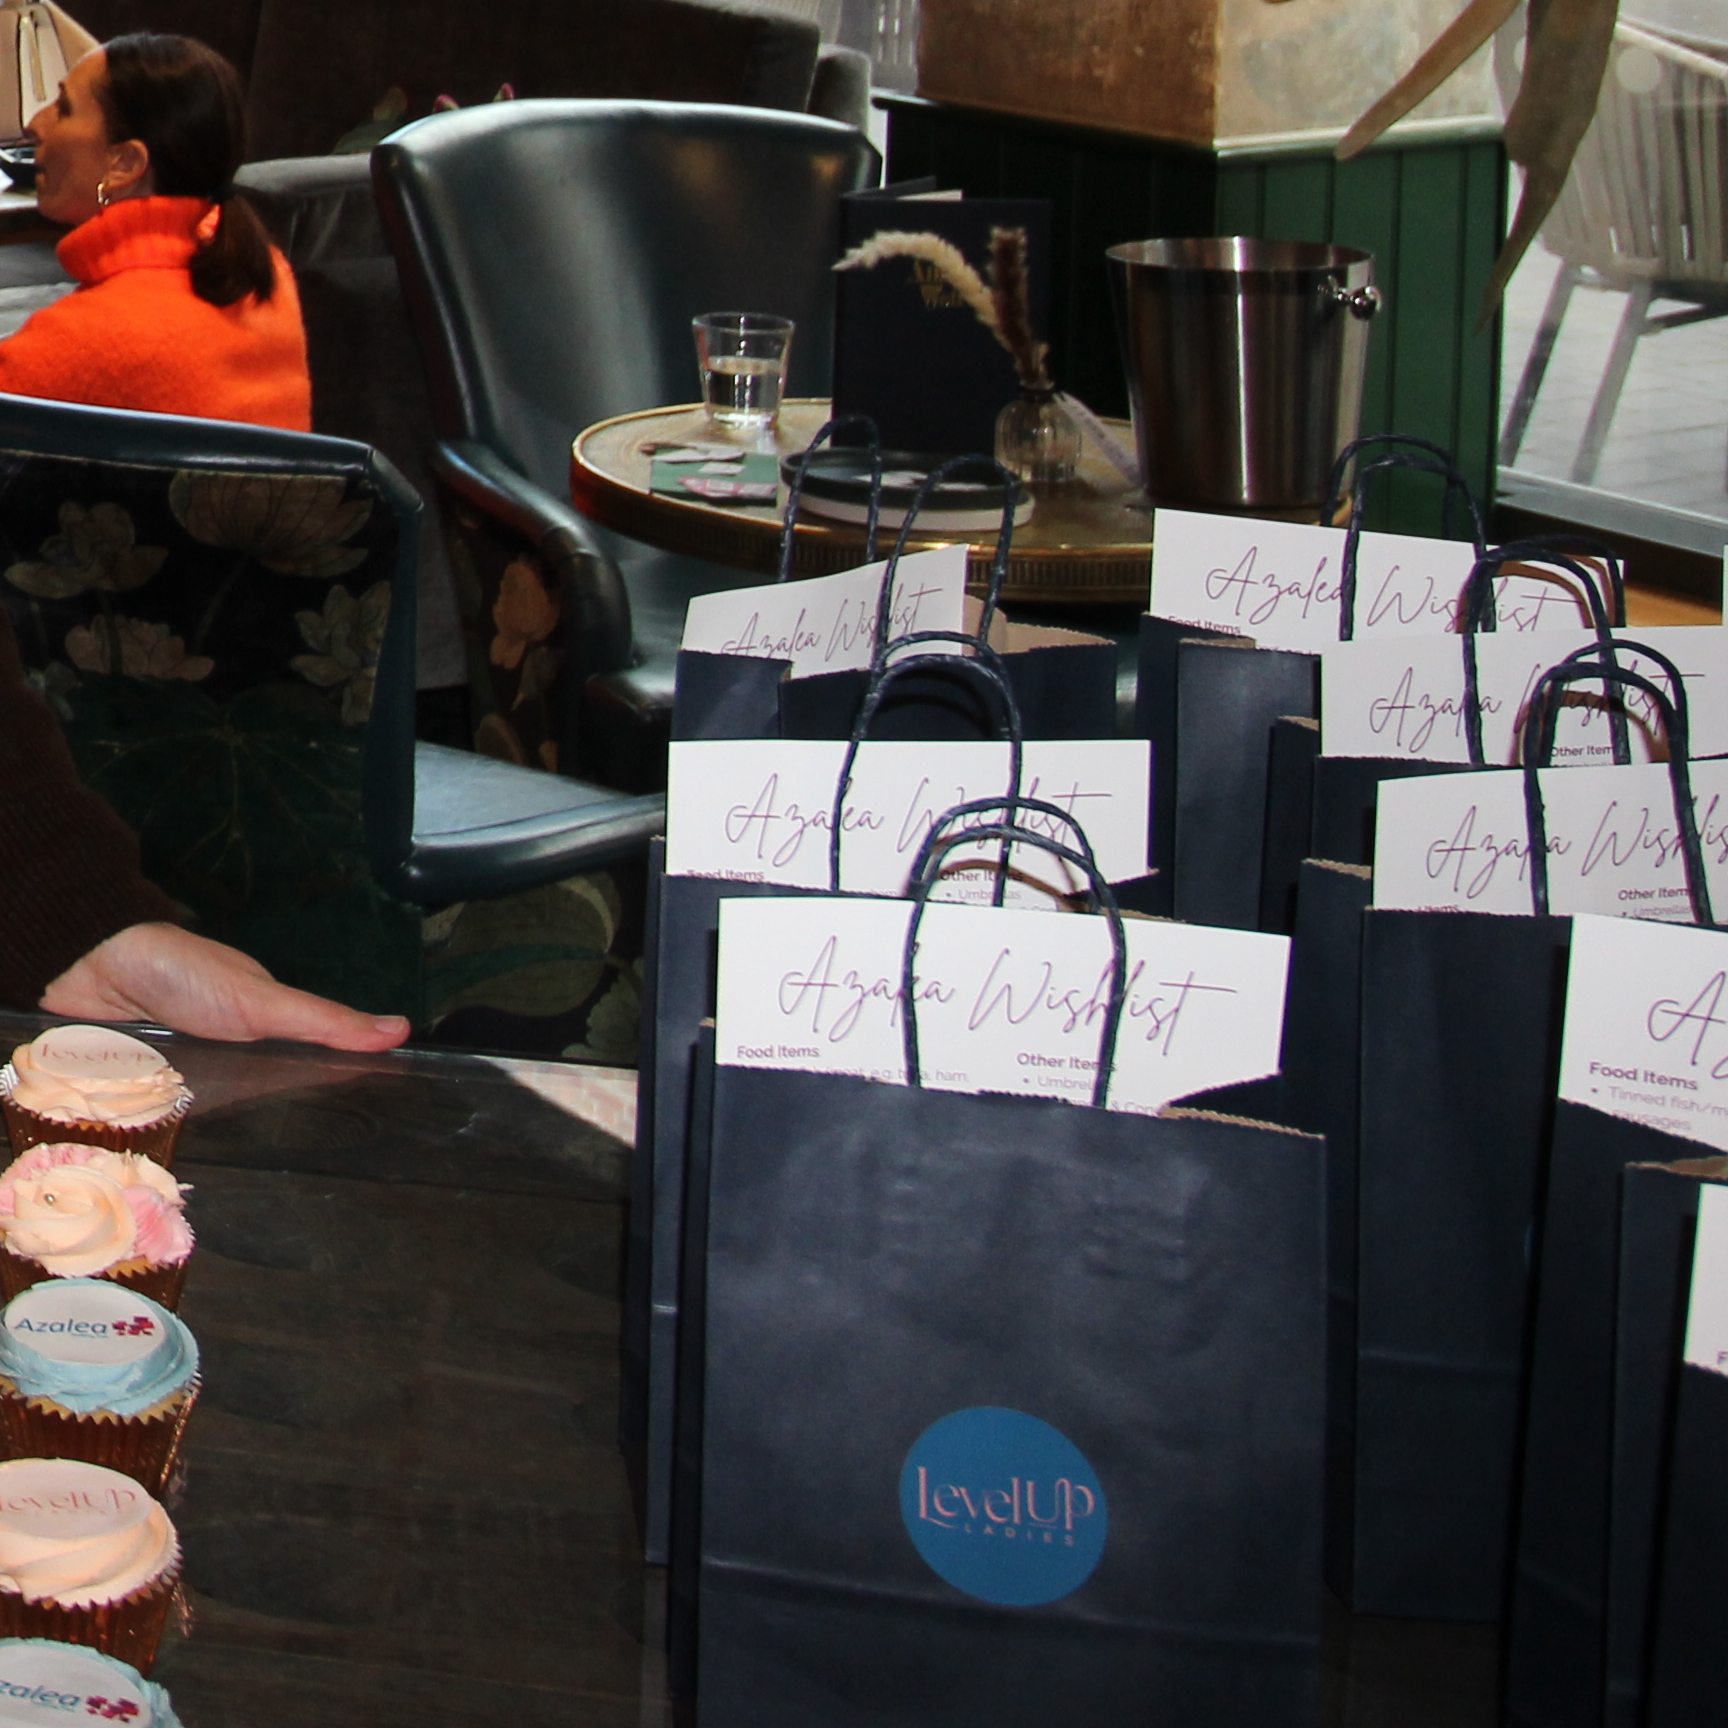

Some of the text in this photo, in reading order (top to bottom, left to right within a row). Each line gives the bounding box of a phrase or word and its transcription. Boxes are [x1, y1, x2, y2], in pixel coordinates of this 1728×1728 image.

[1367, 565, 1584, 633] Wislist
[825, 582, 943, 662] Wislist
[1369, 666, 1502, 753] Azaa
[1588, 744, 1615, 757] Item
[1425, 793, 1728, 900] Azaa Wislis
[1618, 887, 1692, 901] Other Item
[736, 1044, 820, 1059] Food Items
[1016, 1052, 1065, 1068] Other
[1589, 1061, 1699, 1091] Food Items
[1608, 1085, 1665, 1107] Tinned
[13, 1317, 109, 1334] Azalea
[964, 1523, 1075, 1547] LADIES
